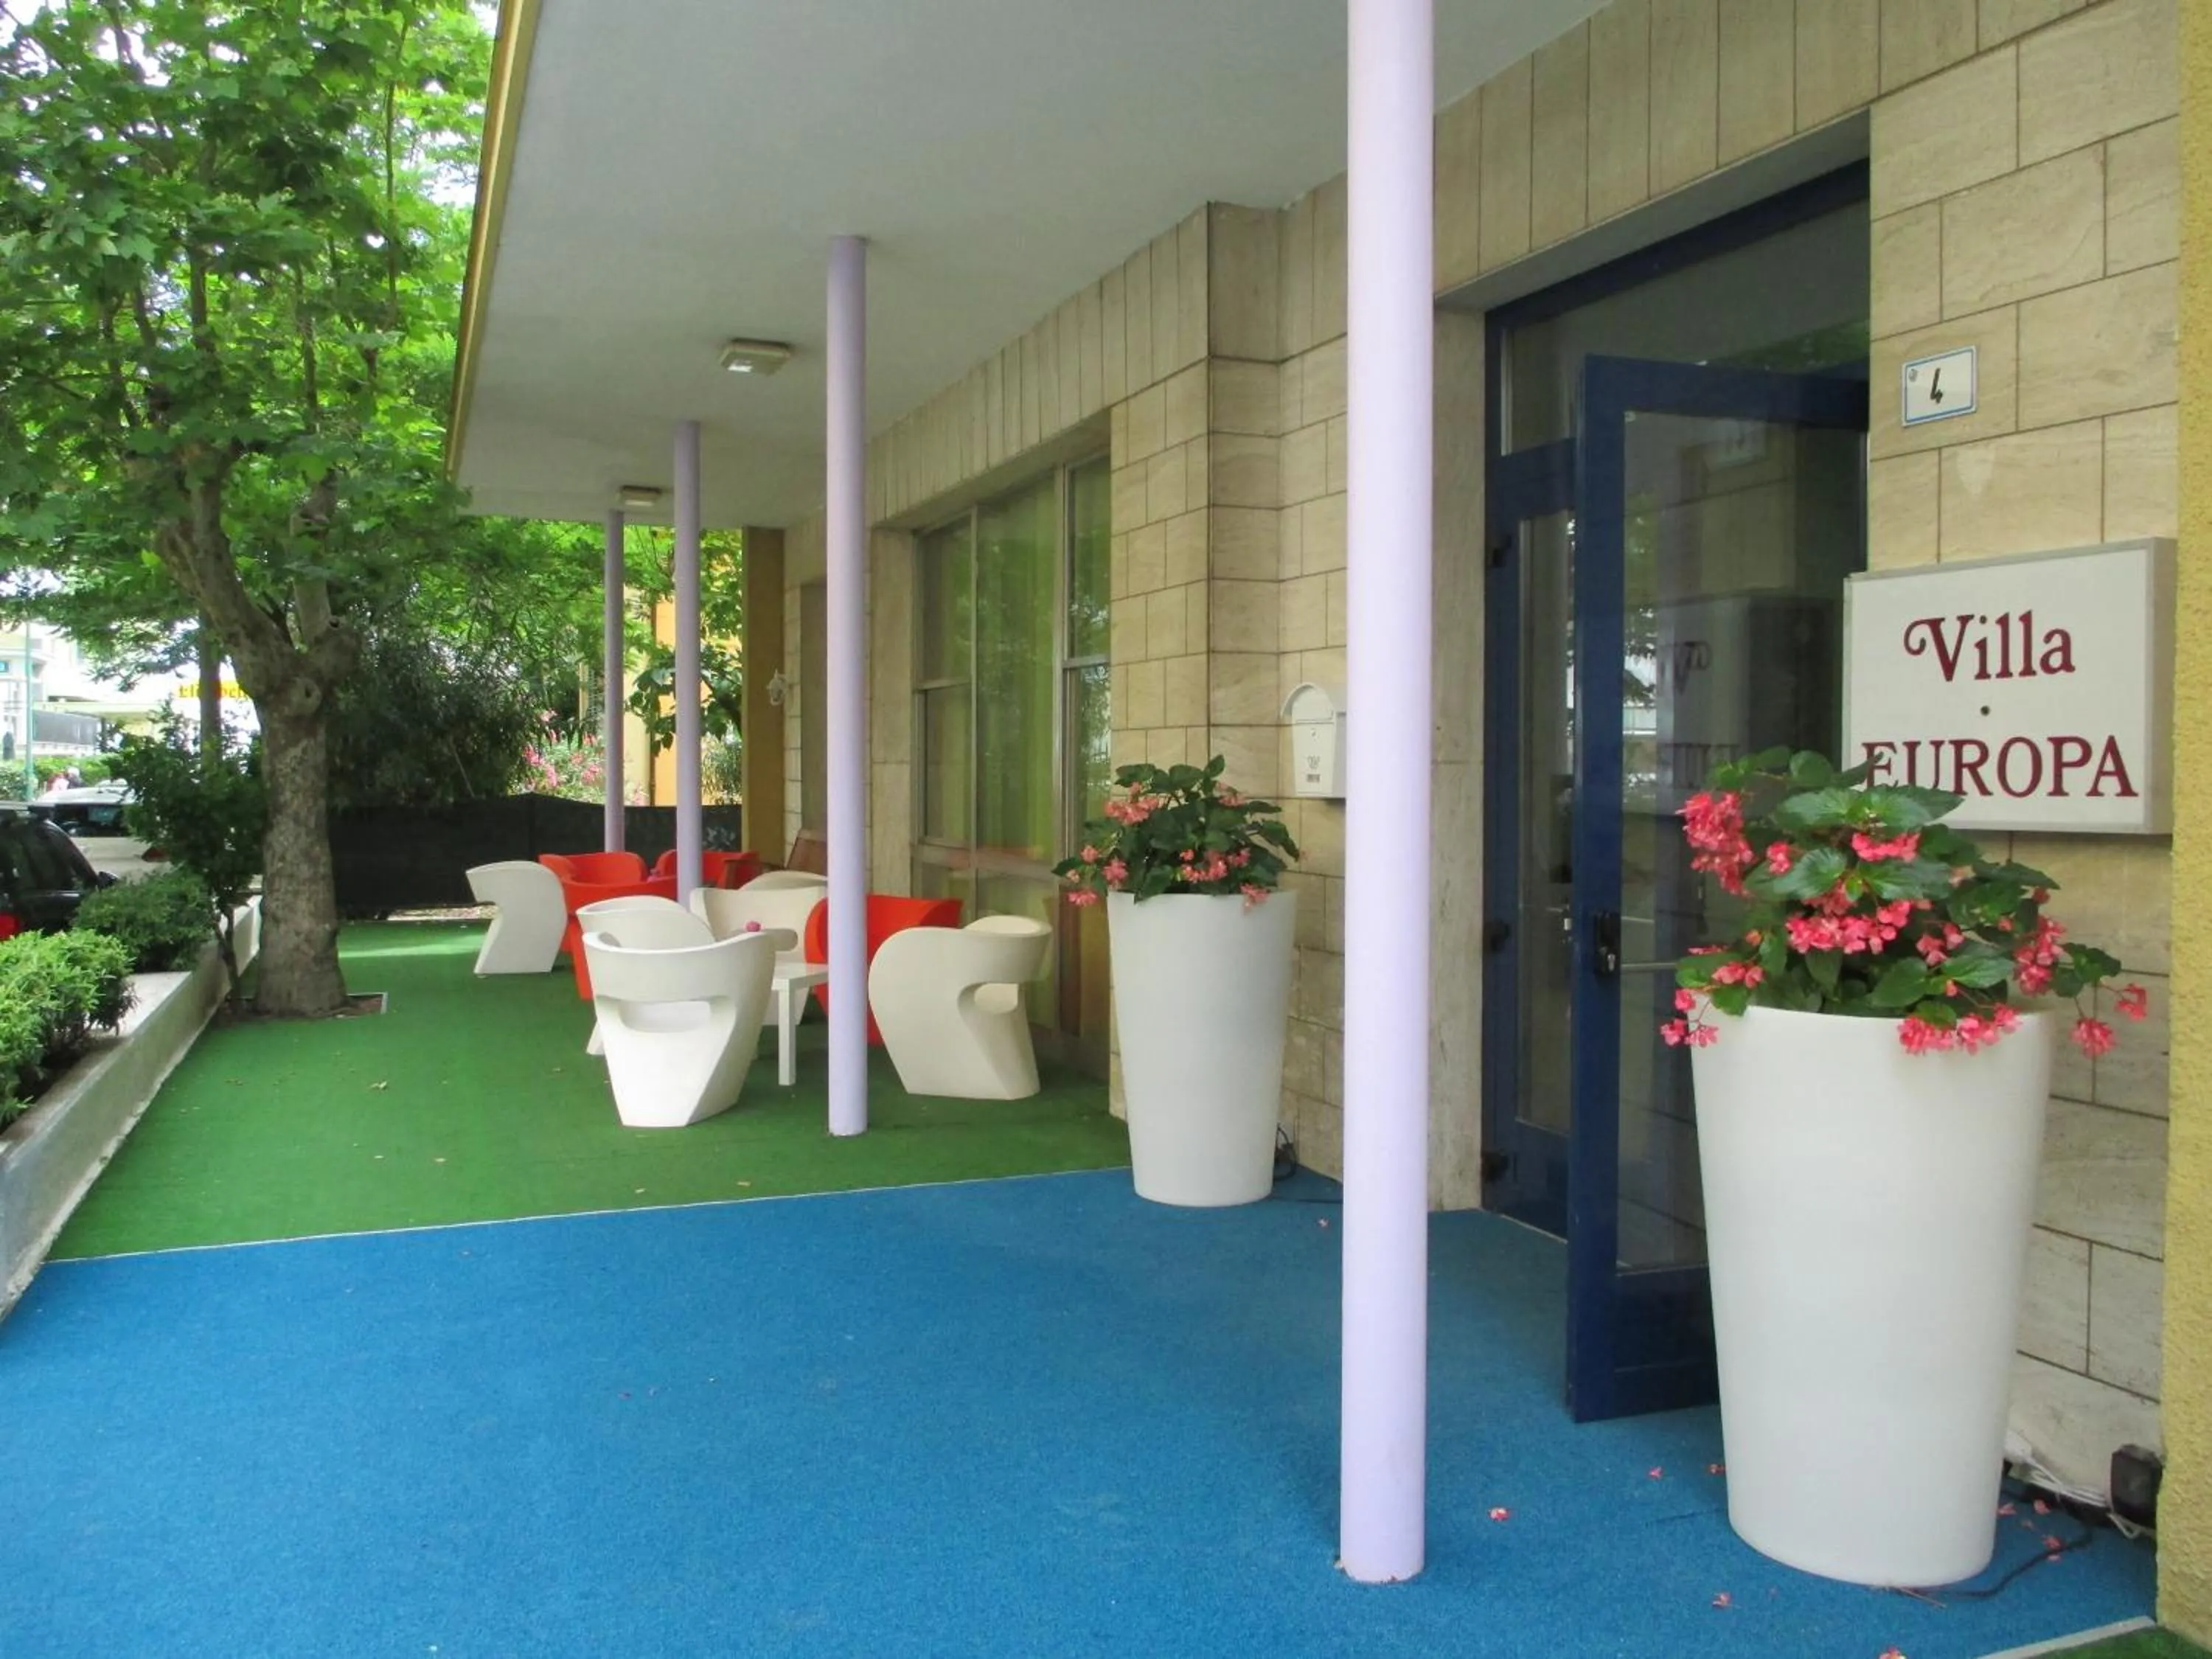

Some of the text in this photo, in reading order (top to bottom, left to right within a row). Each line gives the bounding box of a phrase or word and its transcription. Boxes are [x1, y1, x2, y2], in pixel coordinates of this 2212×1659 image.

[1930, 367, 1944, 405] 4
[1903, 609, 2076, 682] Villa
[1862, 734, 2139, 799] EUROPA
